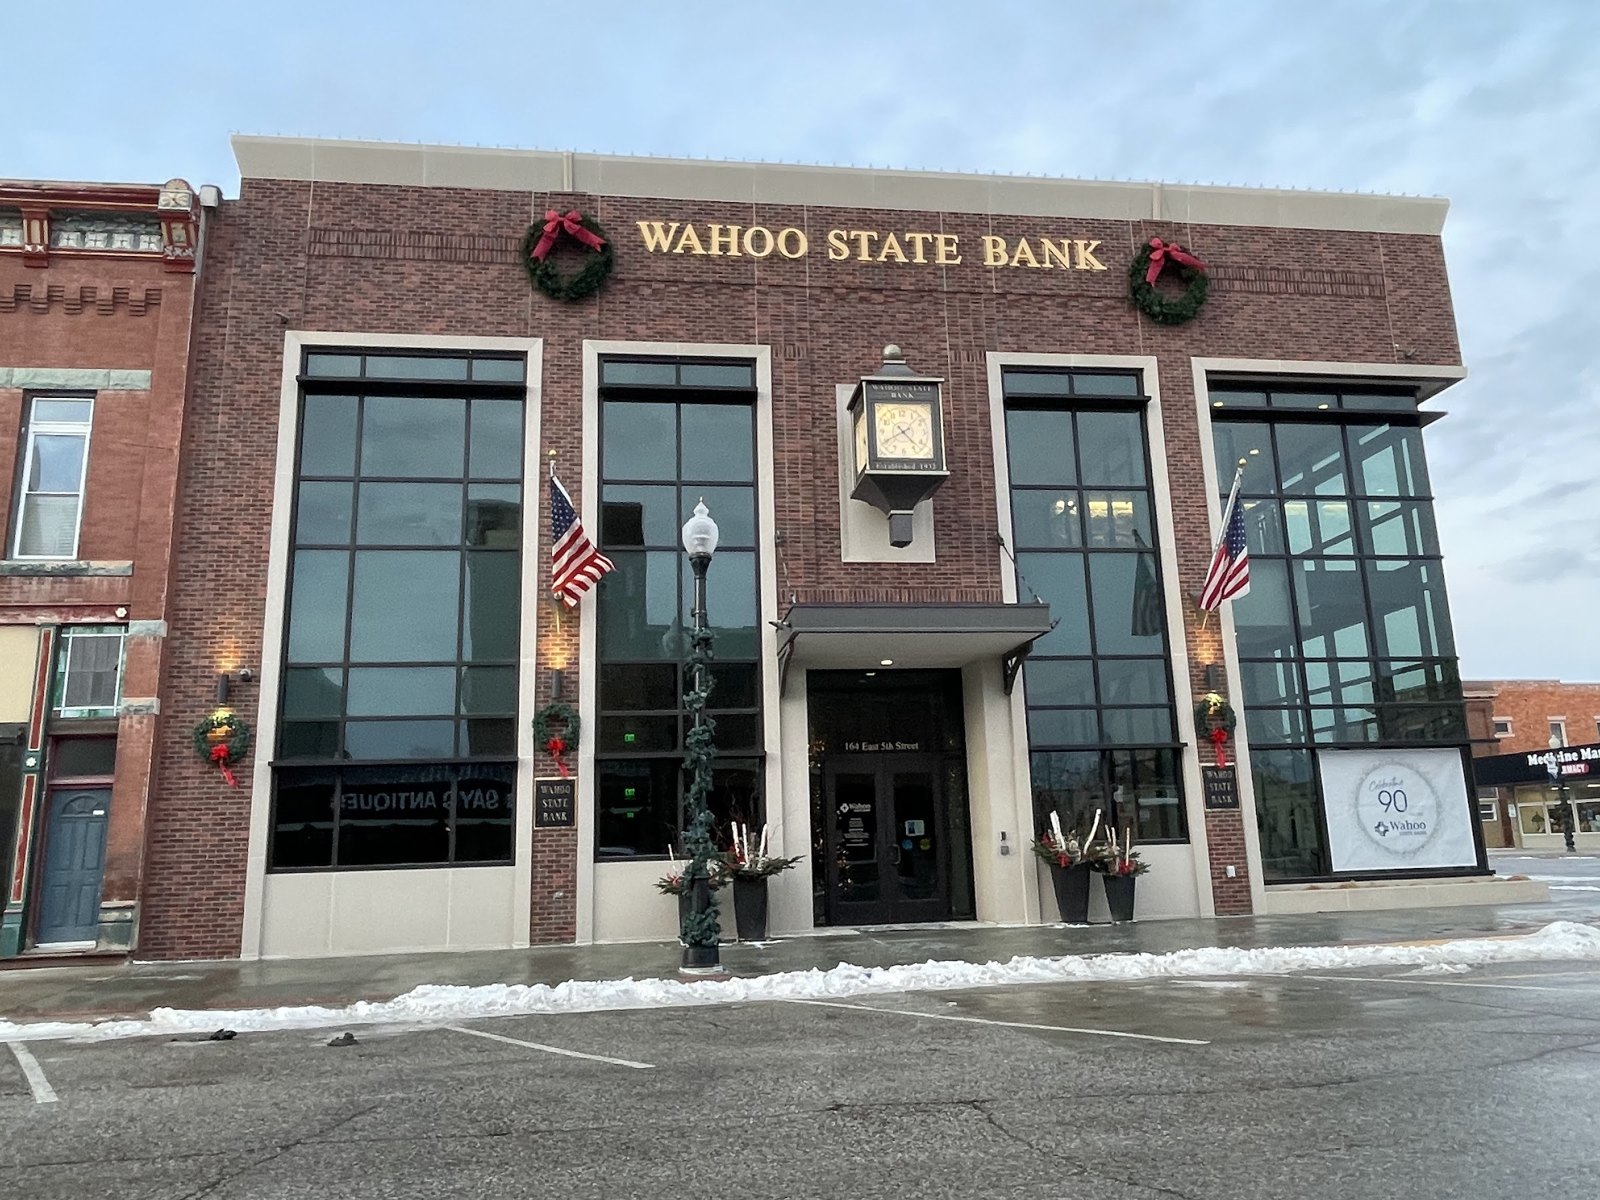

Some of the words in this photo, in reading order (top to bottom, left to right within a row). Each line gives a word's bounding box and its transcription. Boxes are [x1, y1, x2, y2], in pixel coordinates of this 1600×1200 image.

[636, 221, 808, 259] WAHOO
[828, 229, 962, 265] STATE
[982, 235, 1107, 270] BANK
[845, 742, 859, 751] 164
[862, 741, 879, 751] East
[880, 741, 894, 751] 5th
[895, 741, 919, 750] Street
[540, 785, 571, 794] WAHOO
[542, 798, 568, 808] STATE
[1378, 789, 1408, 813] 90
[543, 812, 568, 821] BANK
[1390, 820, 1427, 831] Wahoo
